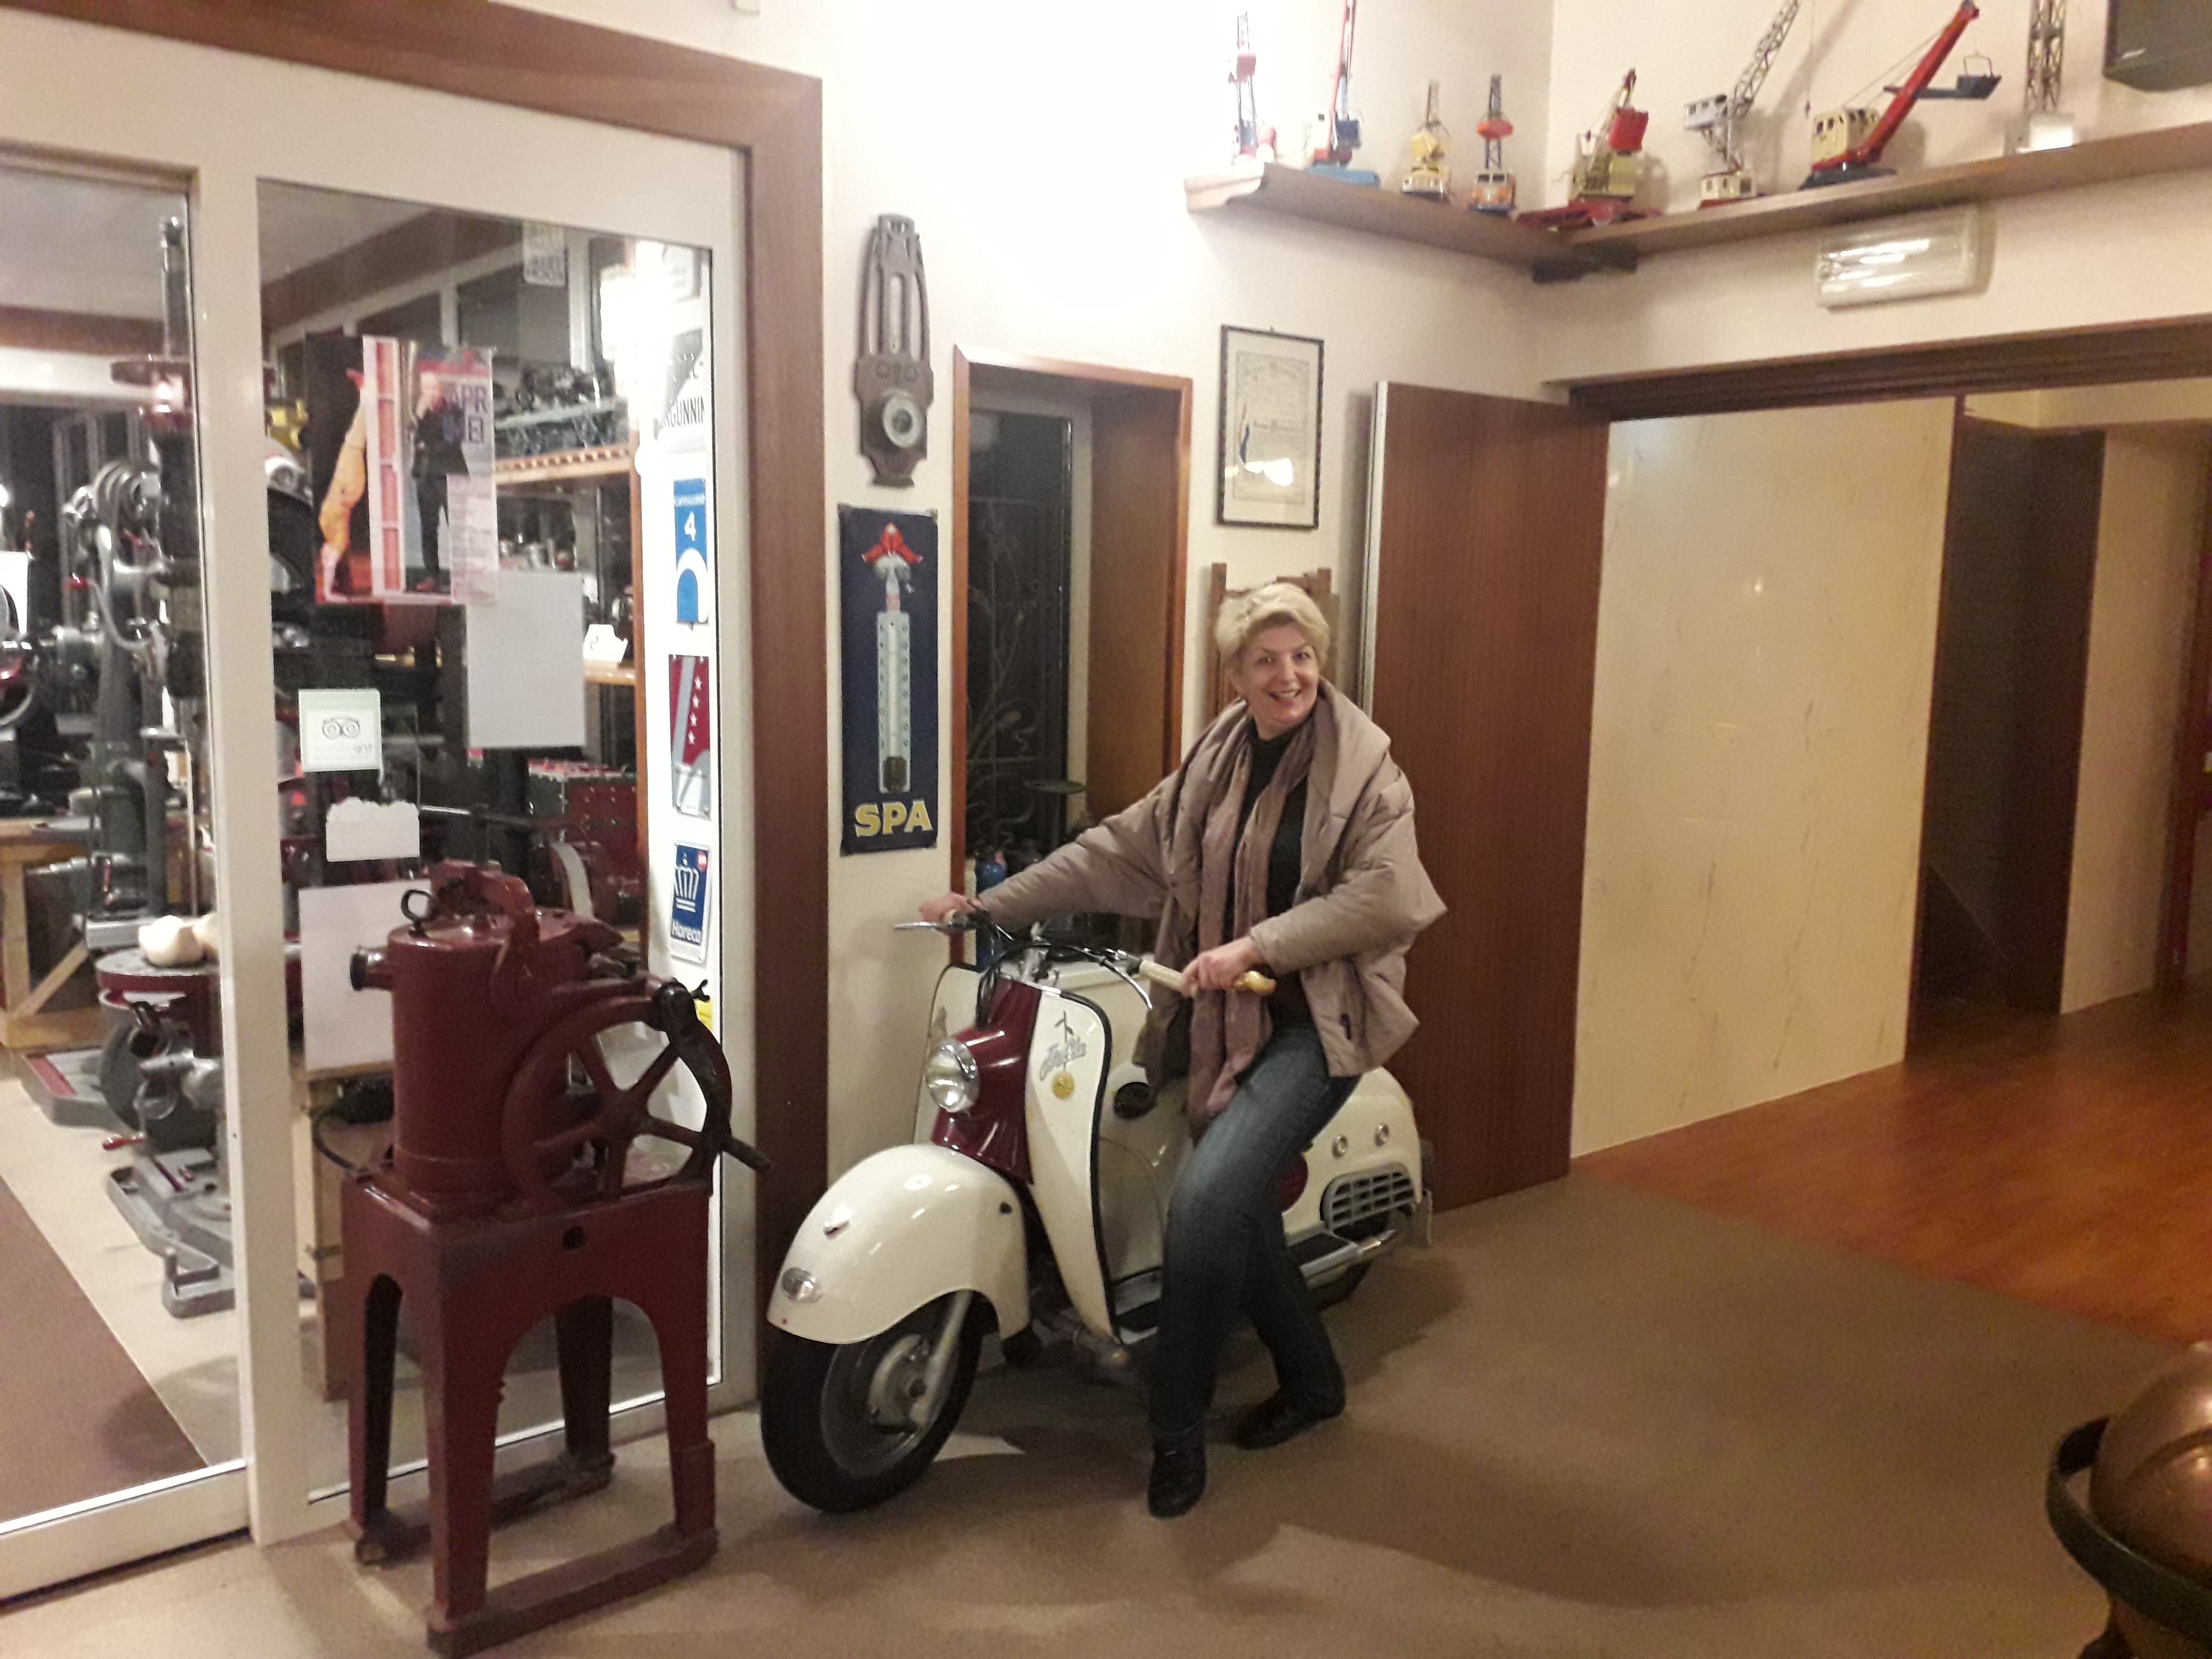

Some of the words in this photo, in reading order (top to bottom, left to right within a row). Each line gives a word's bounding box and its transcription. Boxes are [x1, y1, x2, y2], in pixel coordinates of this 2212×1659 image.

[684, 511, 697, 542] 4
[854, 799, 934, 839] SPA
[672, 920, 701, 943] Horeca
